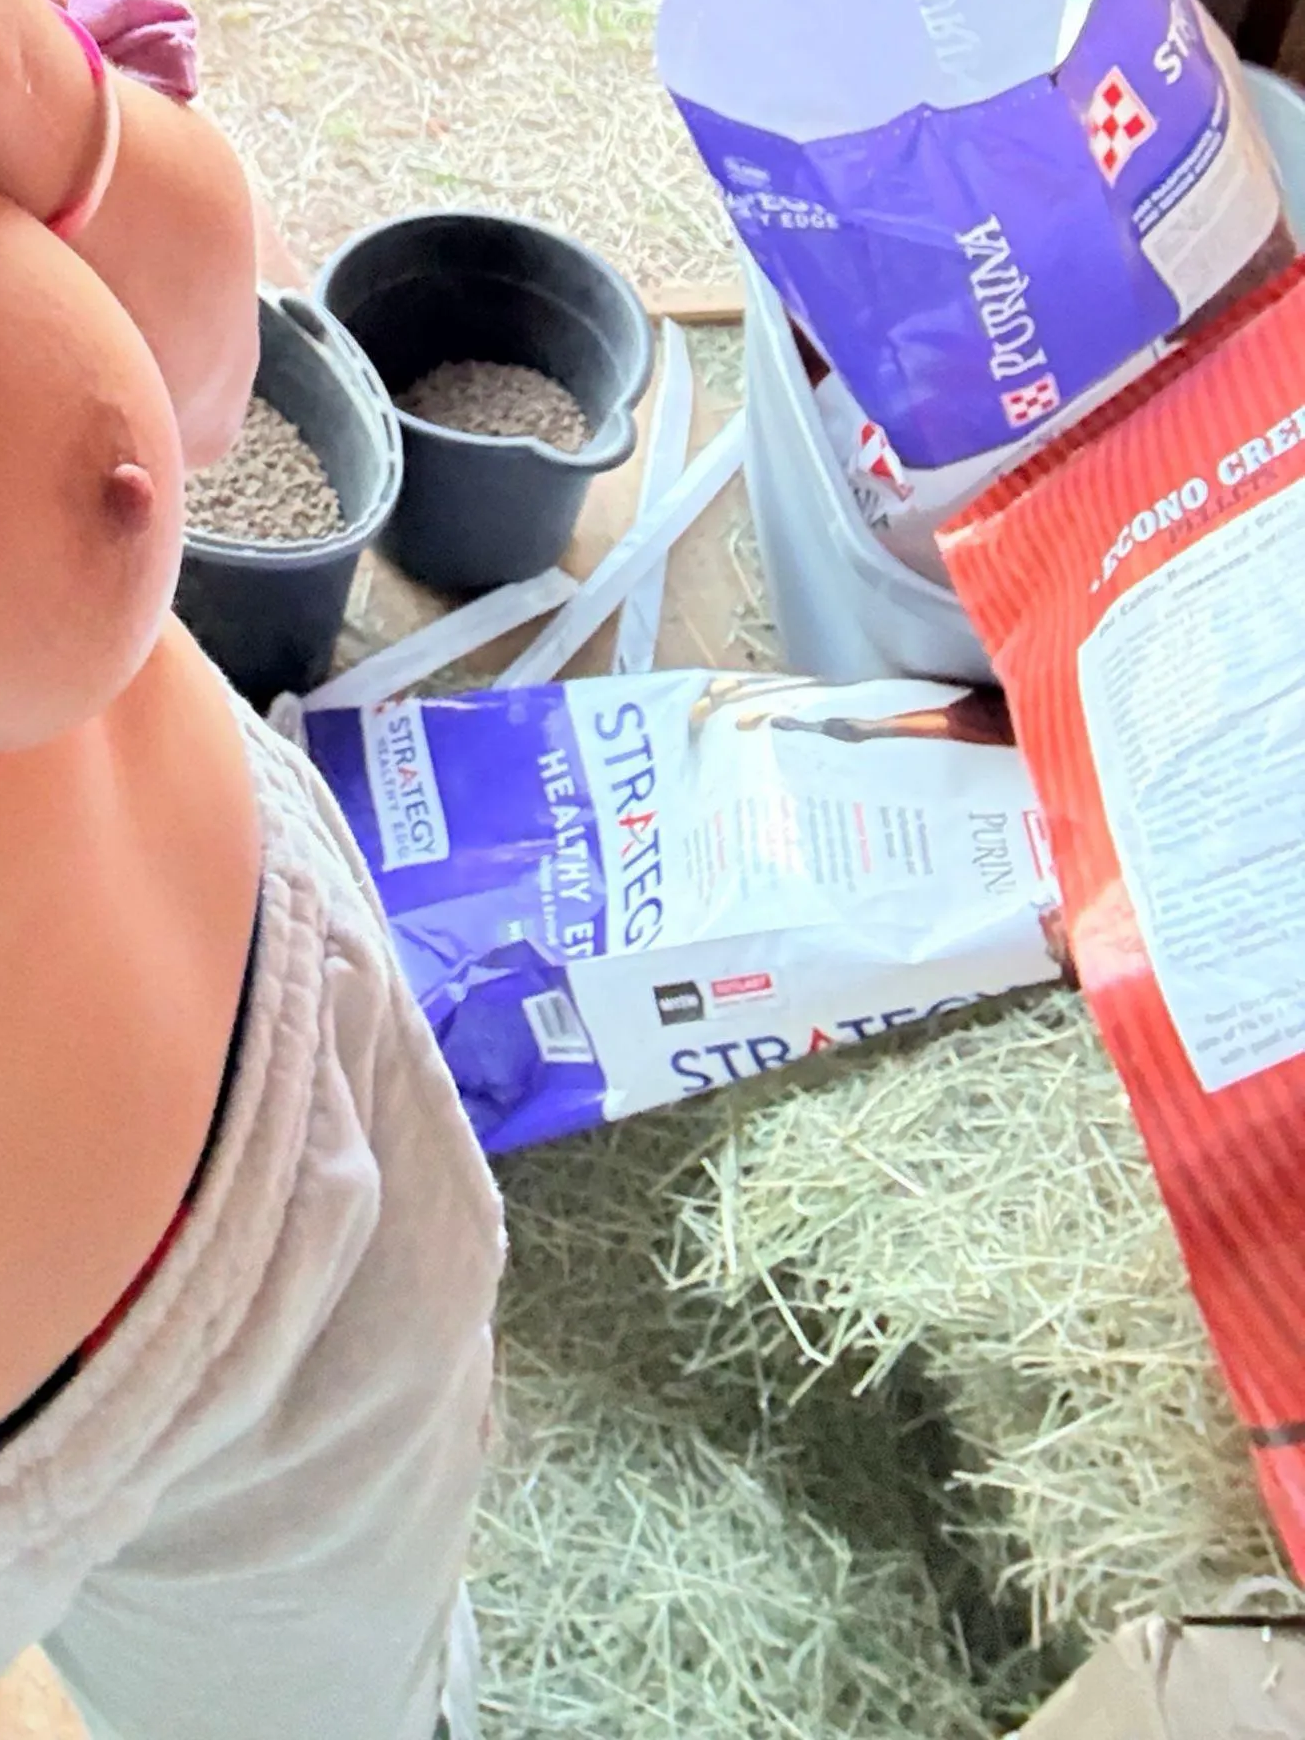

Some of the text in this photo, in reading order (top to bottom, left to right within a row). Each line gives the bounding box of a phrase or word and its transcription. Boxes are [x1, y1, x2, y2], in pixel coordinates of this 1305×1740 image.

[954, 213, 1048, 381] PURINA
[389, 715, 436, 854] STRATEGY
[538, 747, 592, 903] HEALTHY
